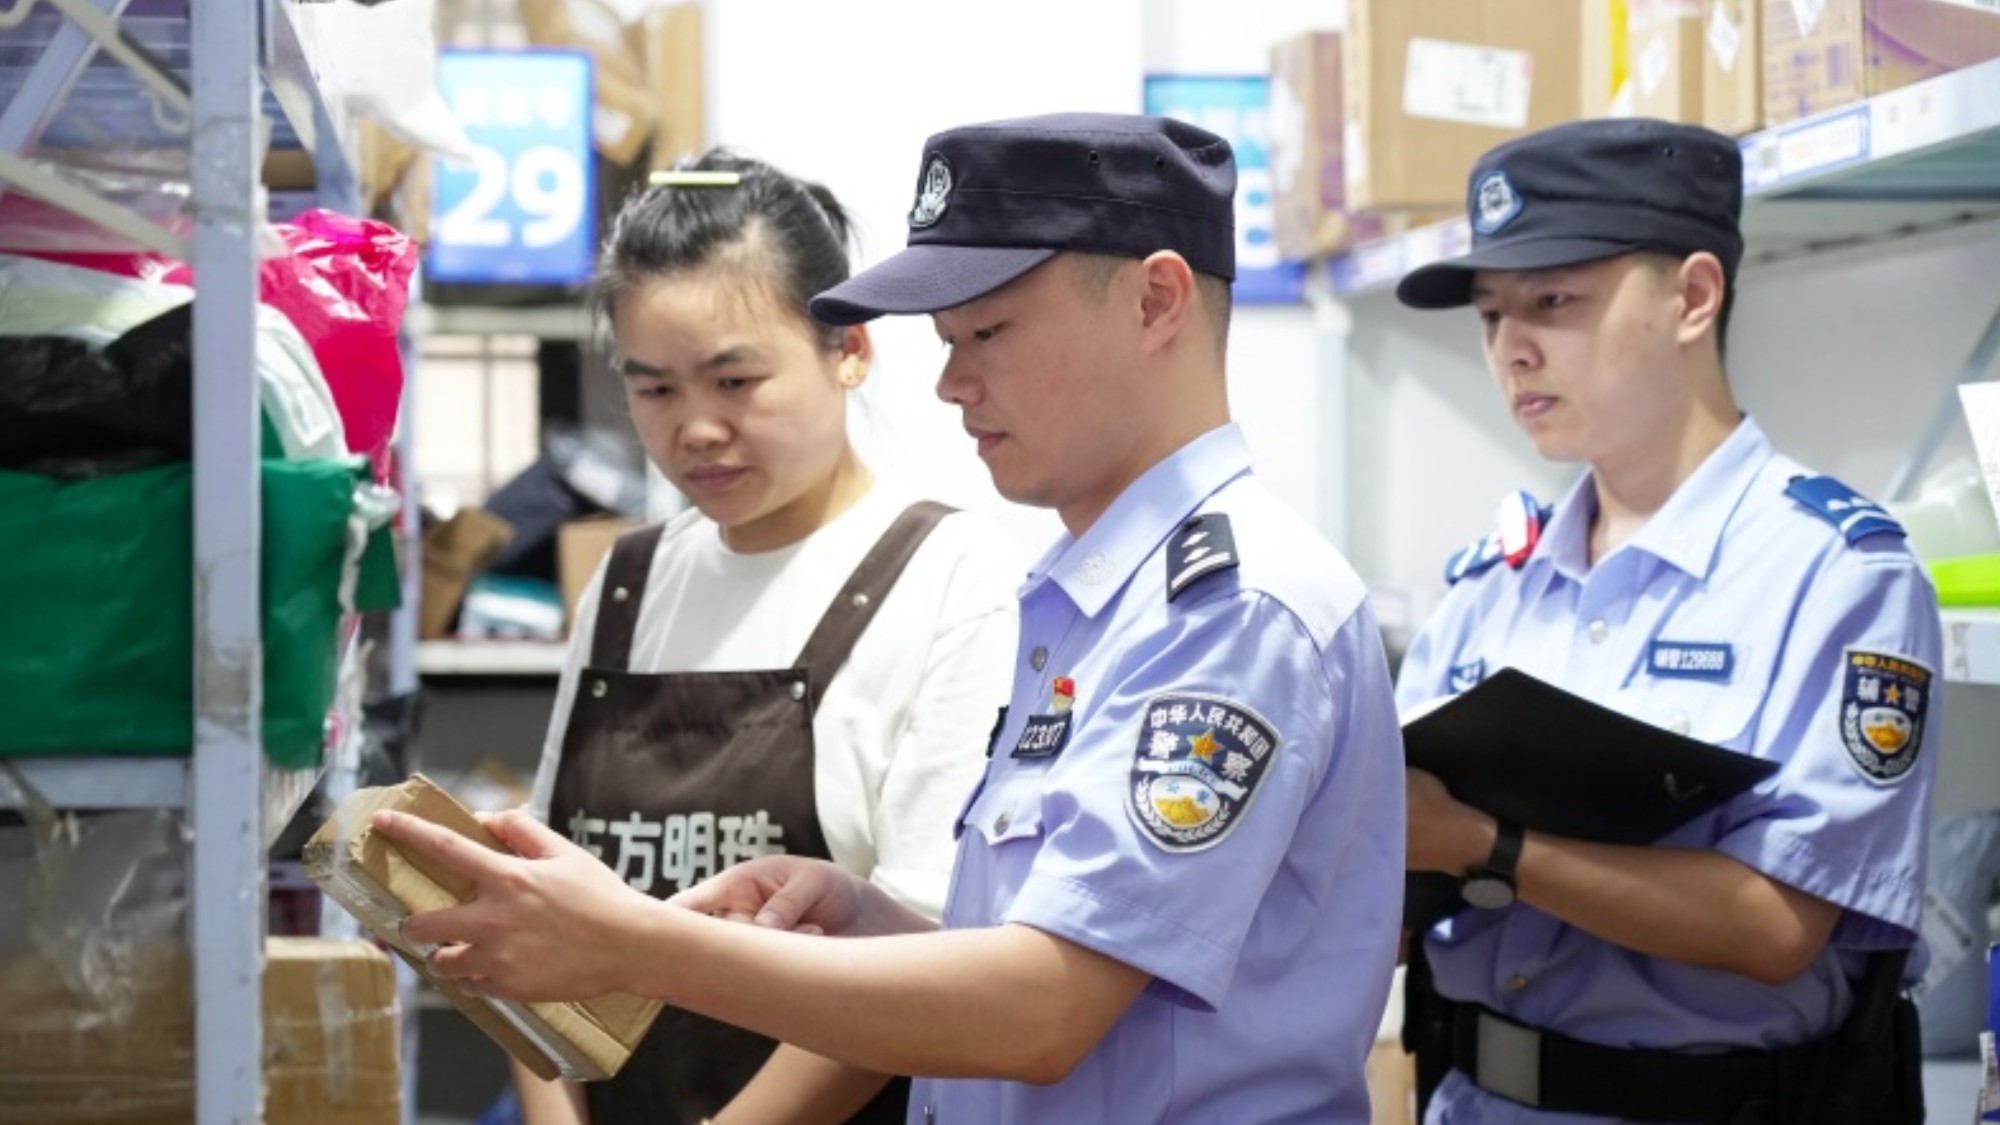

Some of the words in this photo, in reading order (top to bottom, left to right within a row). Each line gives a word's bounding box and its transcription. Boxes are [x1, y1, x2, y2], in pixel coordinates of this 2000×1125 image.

[440, 145, 586, 248] 29
[1151, 702, 1271, 761] 中华人民共和国
